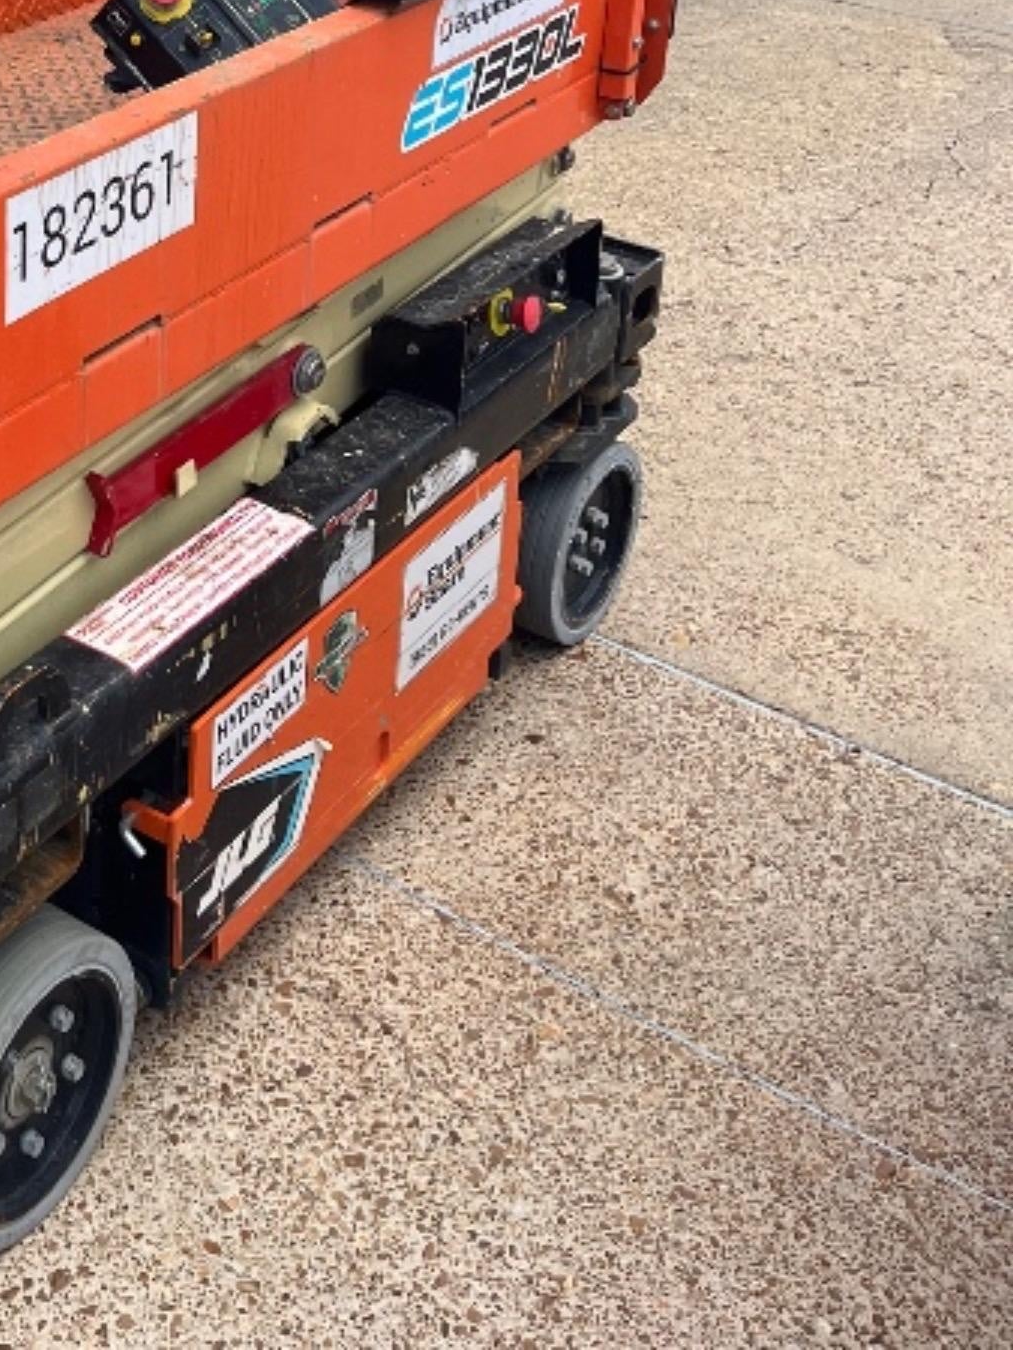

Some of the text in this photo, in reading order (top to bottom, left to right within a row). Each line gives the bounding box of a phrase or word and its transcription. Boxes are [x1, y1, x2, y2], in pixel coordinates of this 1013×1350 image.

[402, 6, 584, 150] ES1330L
[13, 150, 175, 282] 182361
[217, 680, 304, 776] FLUID ONLY
